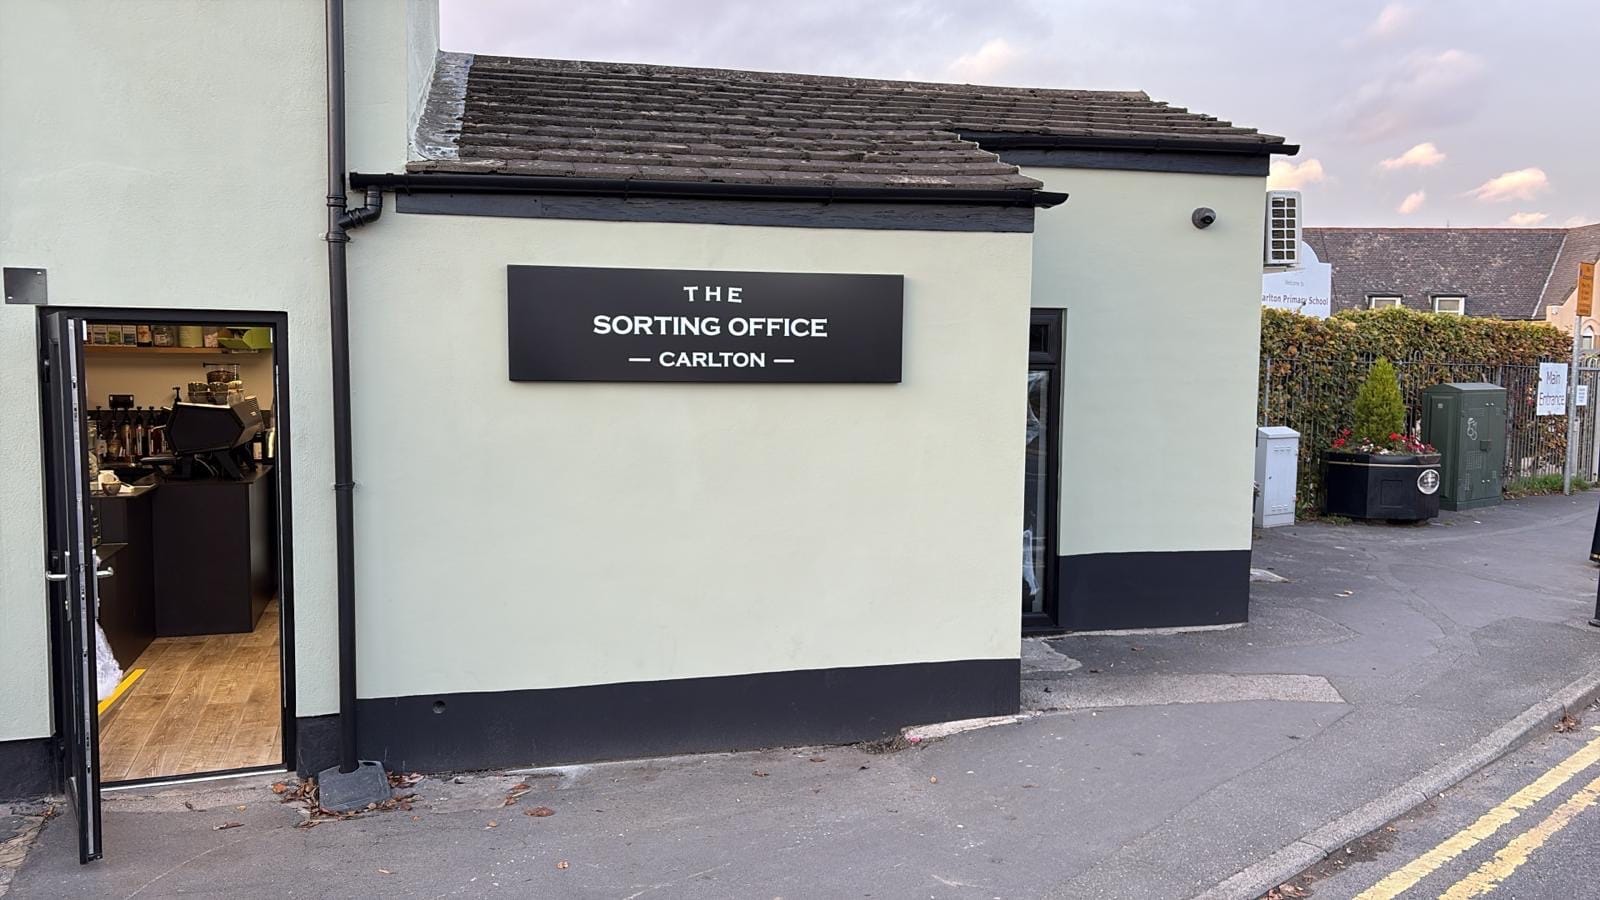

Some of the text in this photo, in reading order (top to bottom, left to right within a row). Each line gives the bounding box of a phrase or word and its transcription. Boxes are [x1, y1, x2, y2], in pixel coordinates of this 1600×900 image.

[683, 286, 742, 303] THE
[1262, 293, 1328, 305] arlton Primary School
[593, 315, 827, 337] SORTING OFFICE
[659, 351, 765, 368] CARLTON
[1546, 371, 1561, 385] Main
[1540, 392, 1564, 405] Entrance
